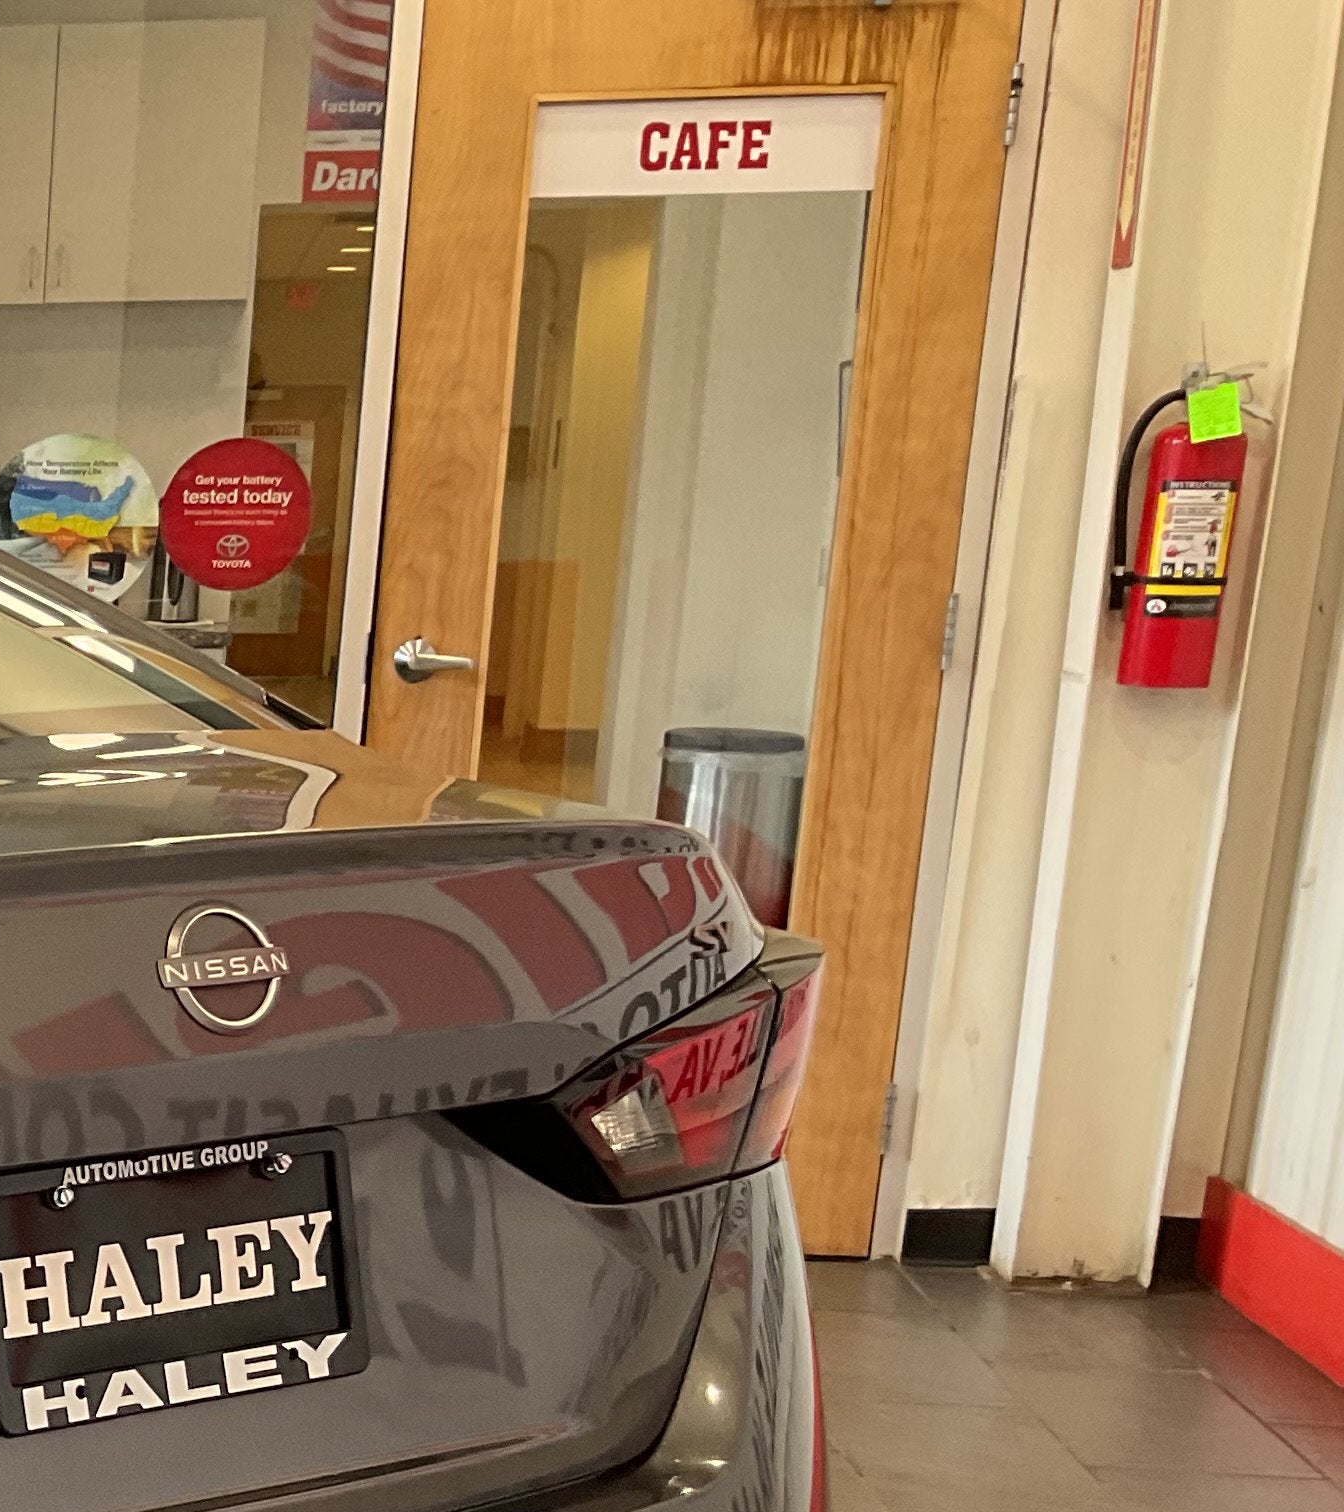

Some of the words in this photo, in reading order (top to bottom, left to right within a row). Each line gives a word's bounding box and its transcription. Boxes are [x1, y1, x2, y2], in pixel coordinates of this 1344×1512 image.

[640, 120, 772, 171] CAFE
[194, 474, 214, 486] Get
[216, 476, 241, 488] your
[242, 474, 283, 488] battery
[182, 488, 239, 505] tested
[242, 488, 294, 507] today
[211, 559, 252, 569] TOYOTA
[163, 951, 289, 983] NISSAN
[61, 1150, 195, 1188] AUTOMOTIVE
[199, 1140, 270, 1167] GROUP
[21, 1332, 348, 1431] HALEY
